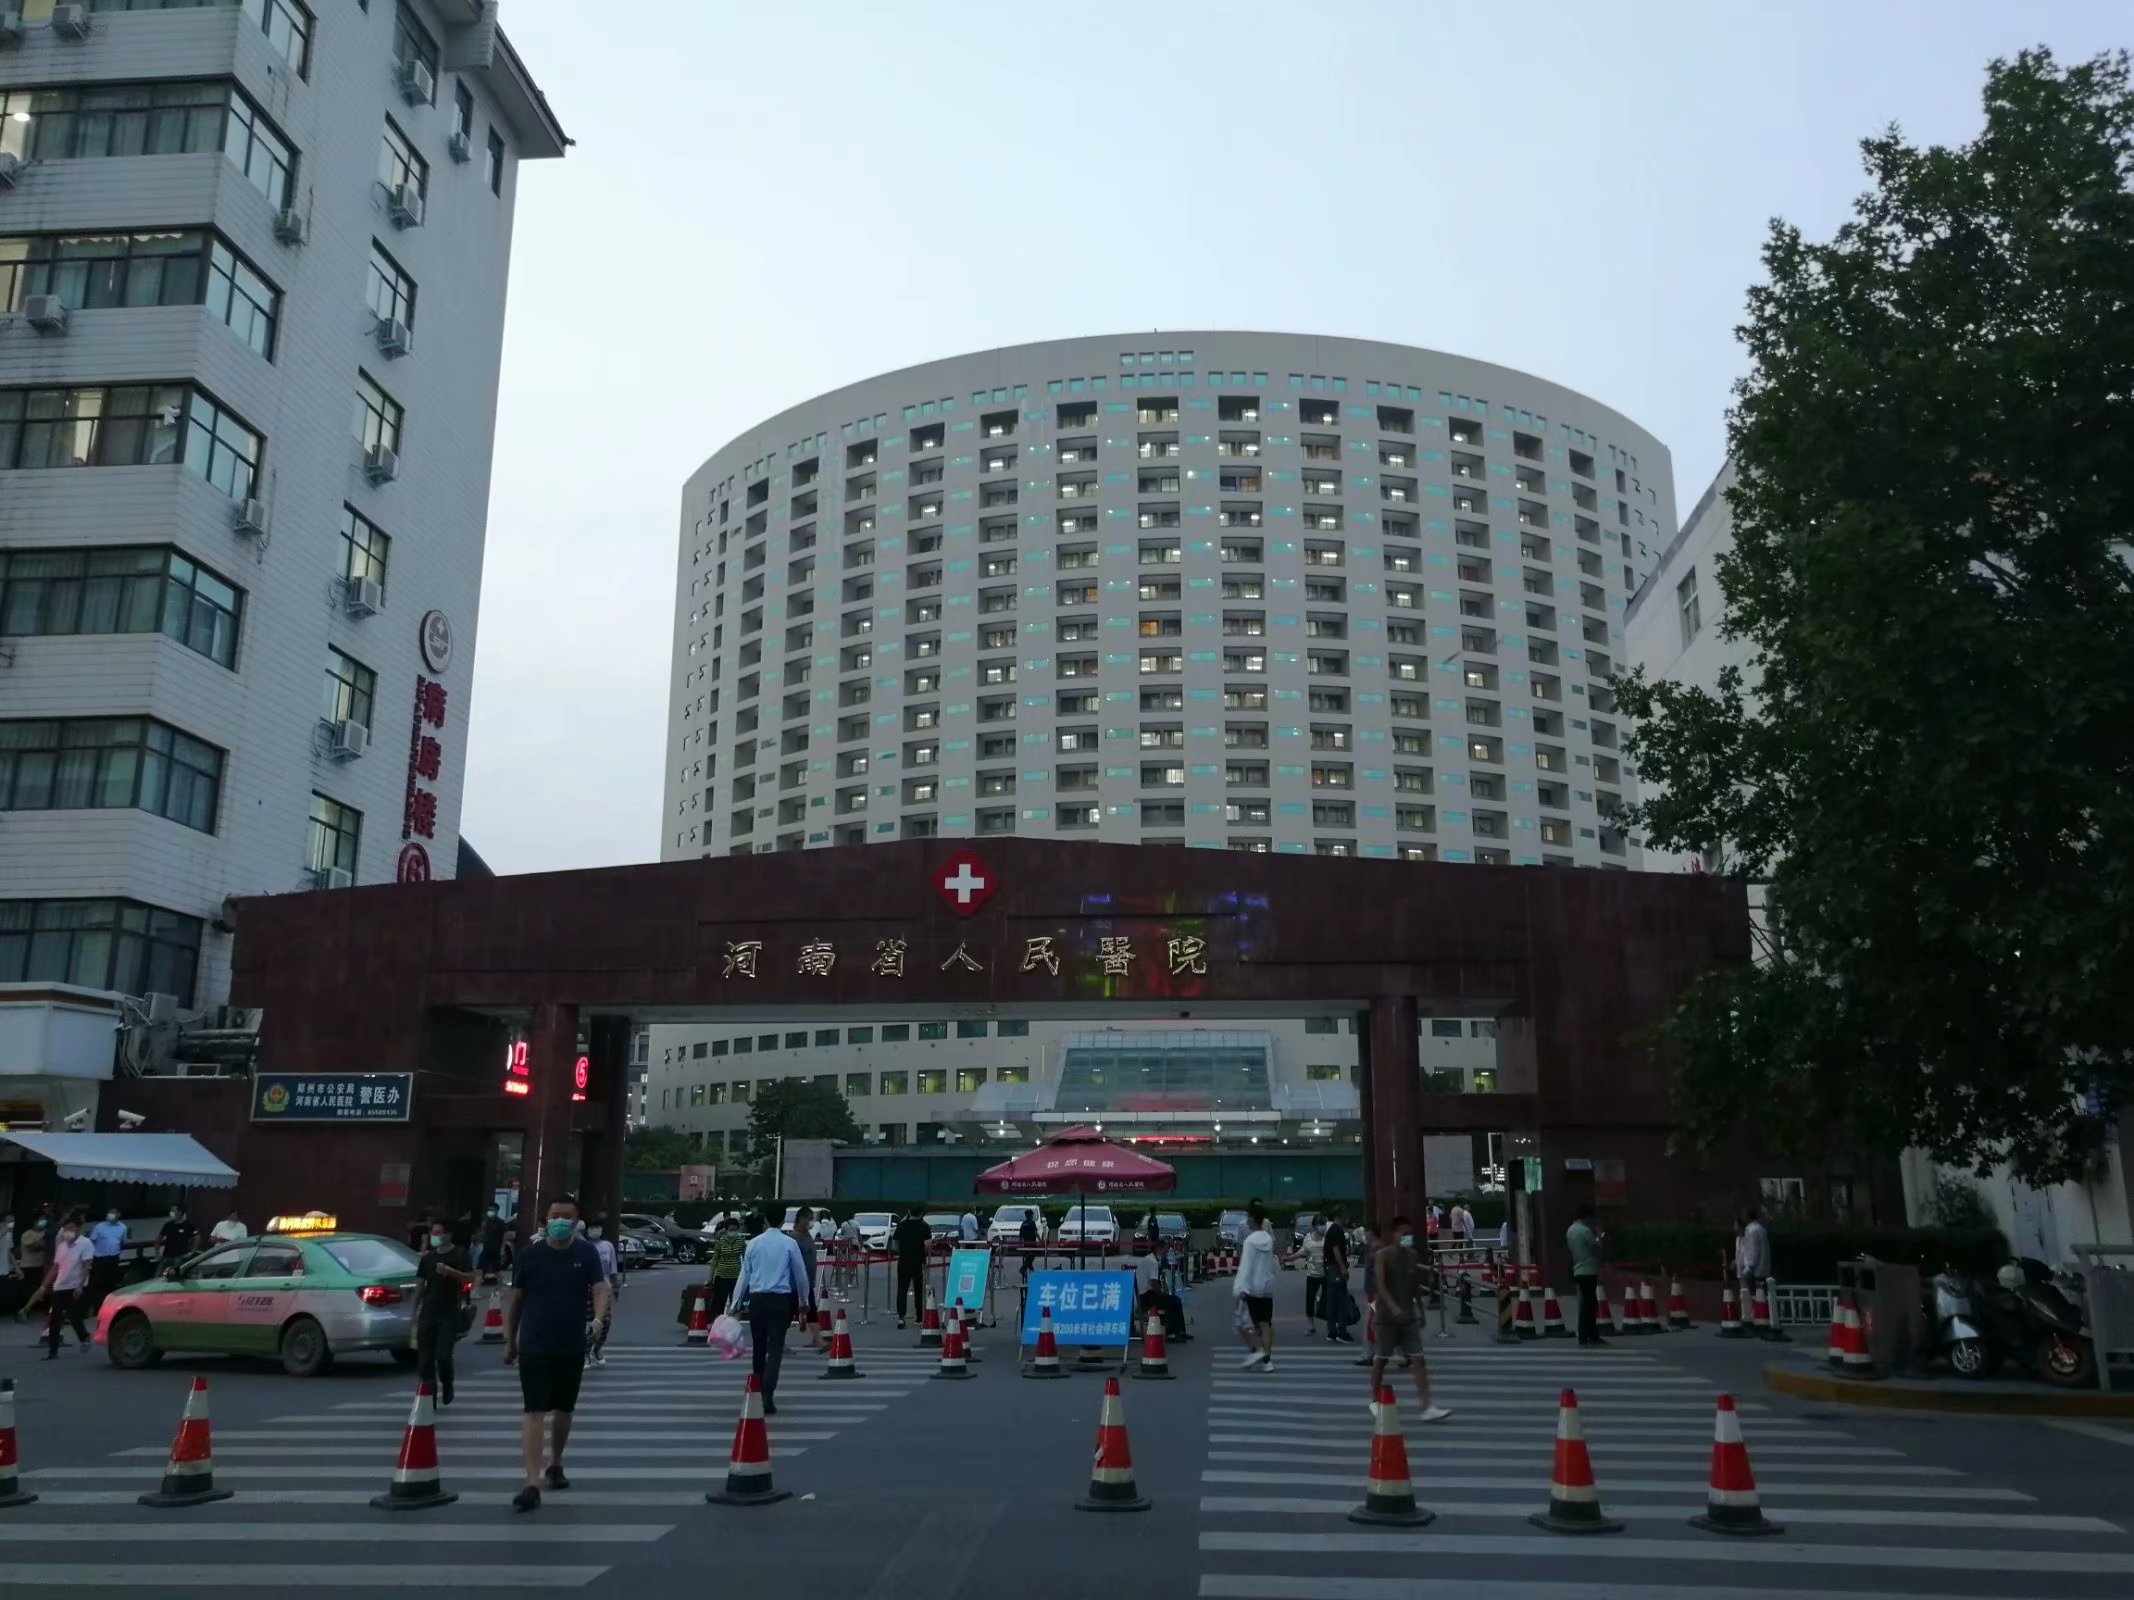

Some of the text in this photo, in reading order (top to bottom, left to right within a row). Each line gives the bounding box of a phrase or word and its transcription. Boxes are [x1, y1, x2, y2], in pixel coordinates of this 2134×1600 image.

[721, 935, 1208, 979] 河南省人民醫院
[297, 1083, 355, 1094] 郑州市公安局
[359, 1086, 400, 1105] 警医办
[295, 1095, 354, 1107] 河南省人民医院
[1037, 1281, 1121, 1312] 车位已满
